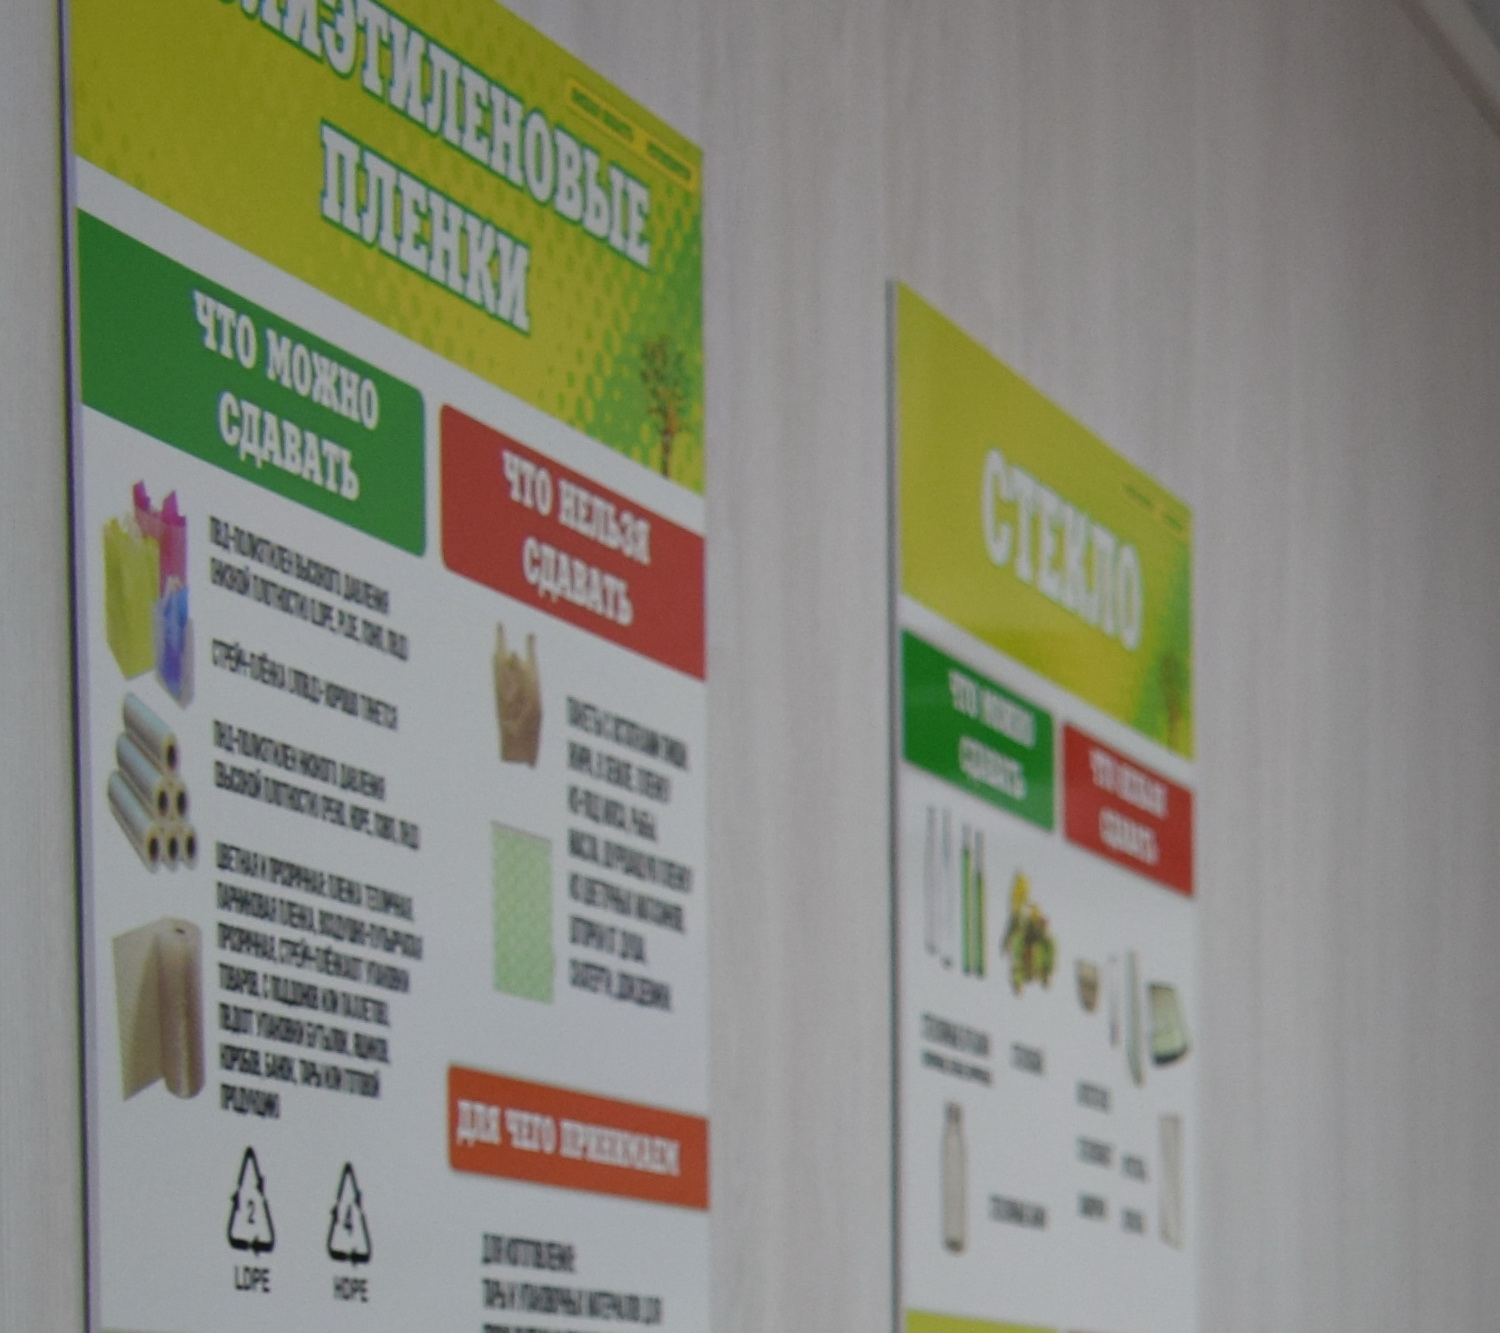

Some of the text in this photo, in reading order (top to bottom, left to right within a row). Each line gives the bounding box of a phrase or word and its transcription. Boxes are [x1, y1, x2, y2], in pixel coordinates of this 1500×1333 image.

[321, 125, 530, 334] ПЛЕНКИ
[195, 290, 379, 430] ЧТО МОЖНО
[218, 393, 360, 501] СДАВАТЬ
[503, 451, 651, 564] ЧТО НЕЛЬЗЯ
[982, 449, 1144, 652] СТЕКЛО
[523, 538, 634, 626] СДАВАТЬ
[456, 1099, 501, 1144] ДЛЯ
[505, 1107, 555, 1156] ЧЕГО
[246, 1200, 257, 1224] 2
[234, 1266, 271, 1293] LDPE
